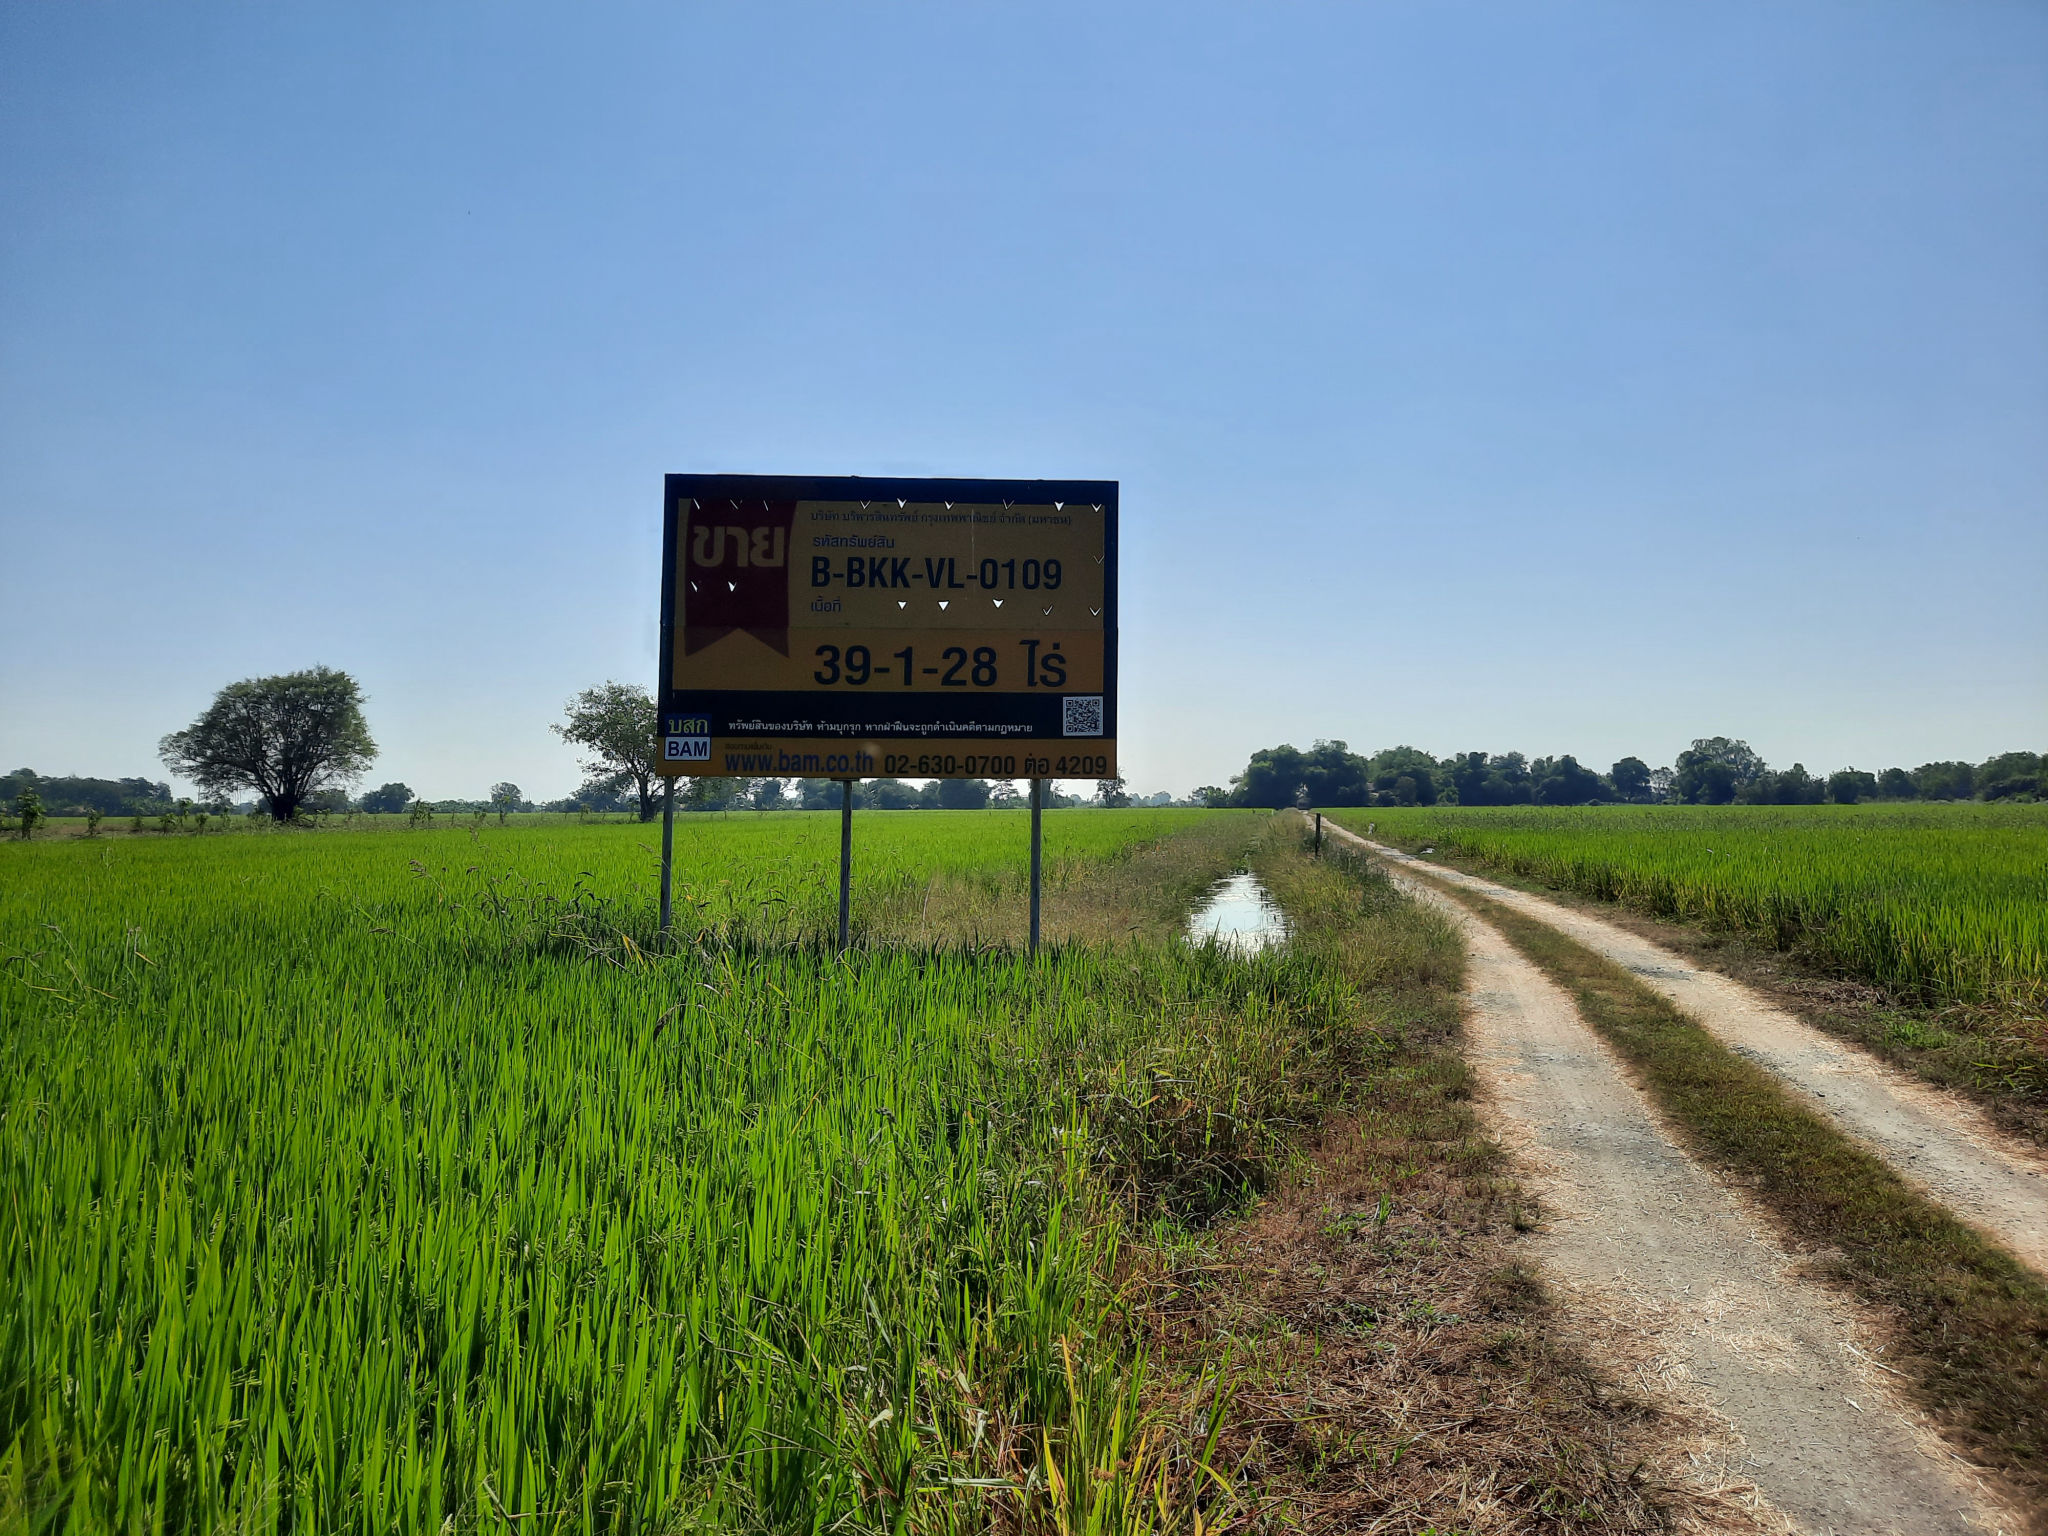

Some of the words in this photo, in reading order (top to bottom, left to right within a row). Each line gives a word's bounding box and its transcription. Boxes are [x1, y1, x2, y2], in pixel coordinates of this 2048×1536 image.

[693, 525, 785, 568] ขาย
[813, 534, 895, 550] รหัสทรัพย์สิน
[811, 557, 1062, 589] B-BKK-VL-0109
[810, 597, 842, 613] เนื้อที่
[813, 645, 997, 686] 39-1-28
[1019, 639, 1067, 687] ไร่
[668, 717, 708, 735] บสก
[728, 719, 813, 733] ทรัพย์สินของบริษัท
[817, 721, 861, 736] ห้ามบุกรุก
[668, 740, 708, 759] BAM
[725, 749, 873, 772] www.bam.co.th
[884, 754, 1015, 775] 02-630-0700
[1024, 753, 1048, 775] ต่อ
[1056, 755, 1107, 775] 4209
